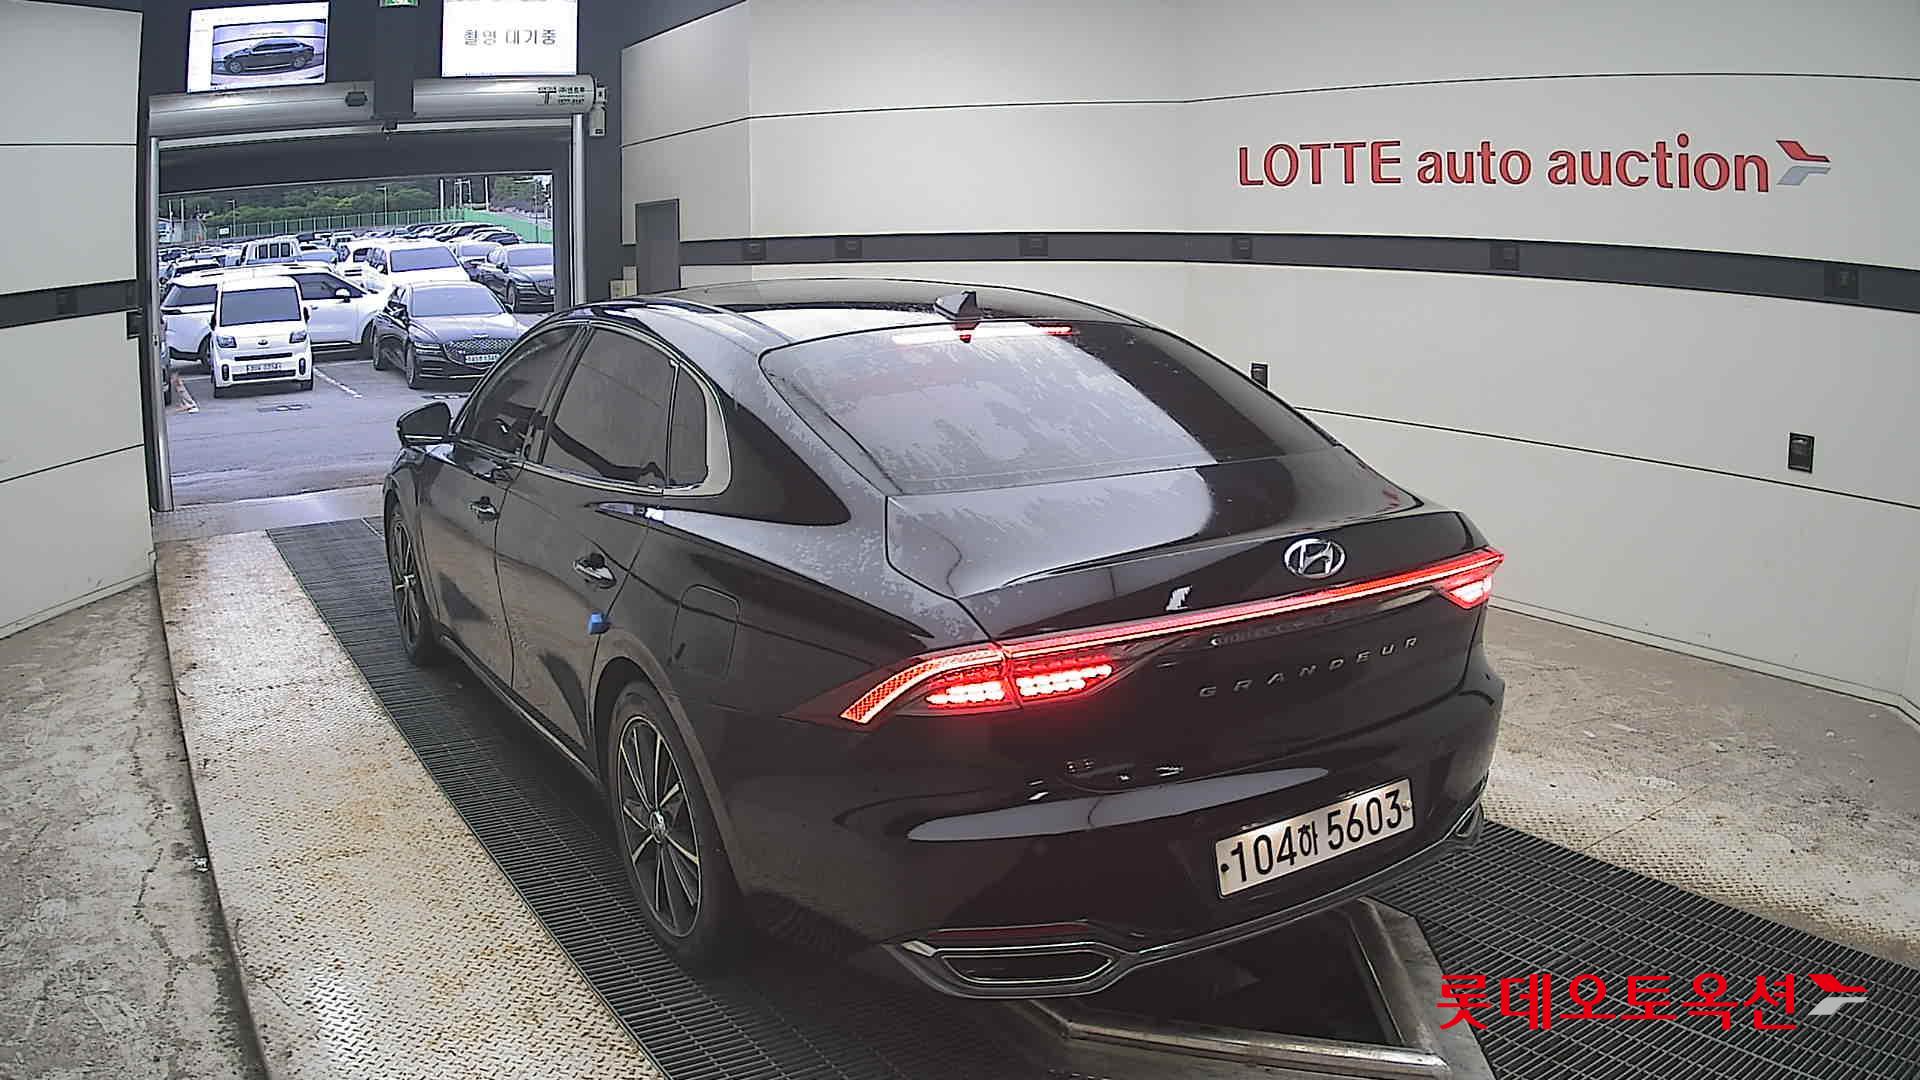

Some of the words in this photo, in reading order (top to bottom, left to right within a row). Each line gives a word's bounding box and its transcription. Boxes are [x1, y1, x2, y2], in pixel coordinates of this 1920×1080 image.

[505, 29, 556, 46] 대기중
[1239, 140, 1401, 186] LOTTE
[1416, 141, 1532, 185] auto
[1548, 133, 1769, 193] auction
[1199, 637, 1417, 697] GRANDEUR
[1231, 821, 1318, 882] 104하
[1327, 789, 1402, 850] 5603
